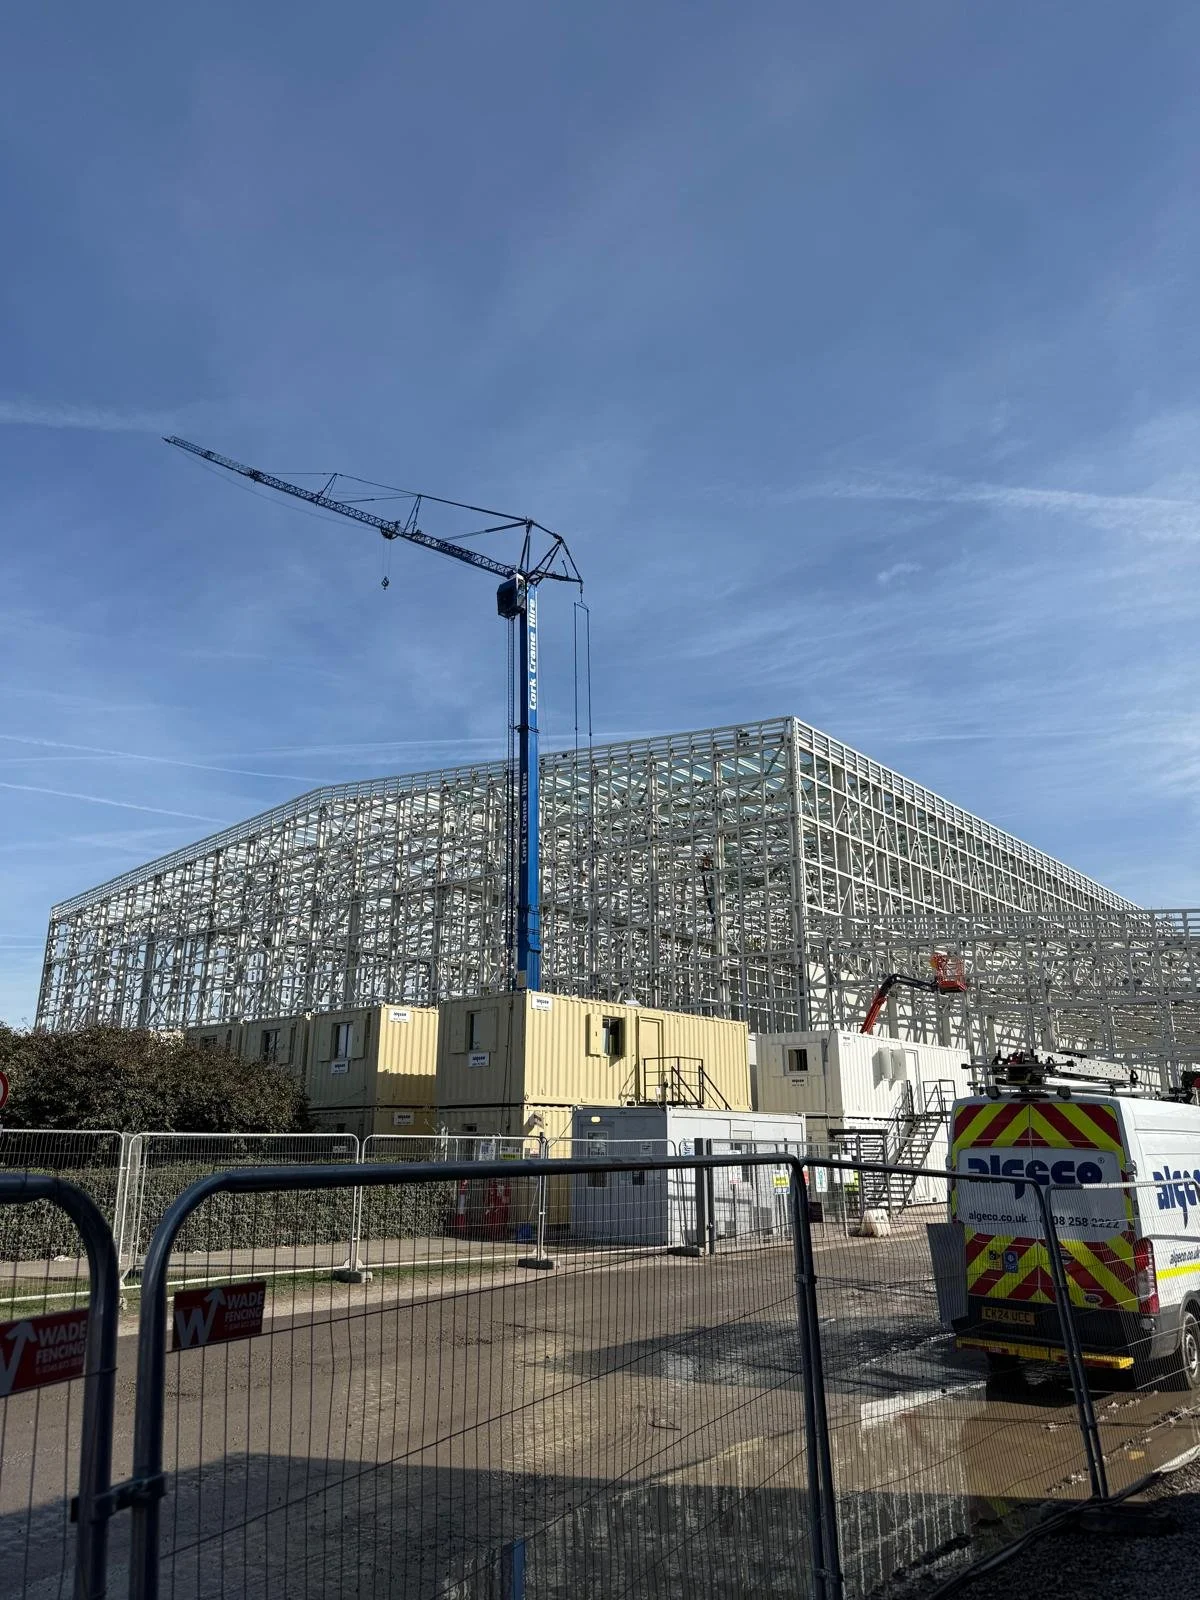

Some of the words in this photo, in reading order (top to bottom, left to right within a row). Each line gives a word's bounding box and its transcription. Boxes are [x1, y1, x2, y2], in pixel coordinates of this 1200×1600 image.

[529, 598, 537, 628] Hire
[529, 632, 537, 673] Crane
[529, 678, 537, 710] Cork
[968, 1210, 1028, 1224] algeco.co.uk
[1068, 1216, 1089, 1228] 258
[226, 1290, 265, 1310] WADE
[224, 1306, 262, 1323] FENCING
[38, 1319, 87, 1348] WADE
[36, 1340, 85, 1365] FENCING
